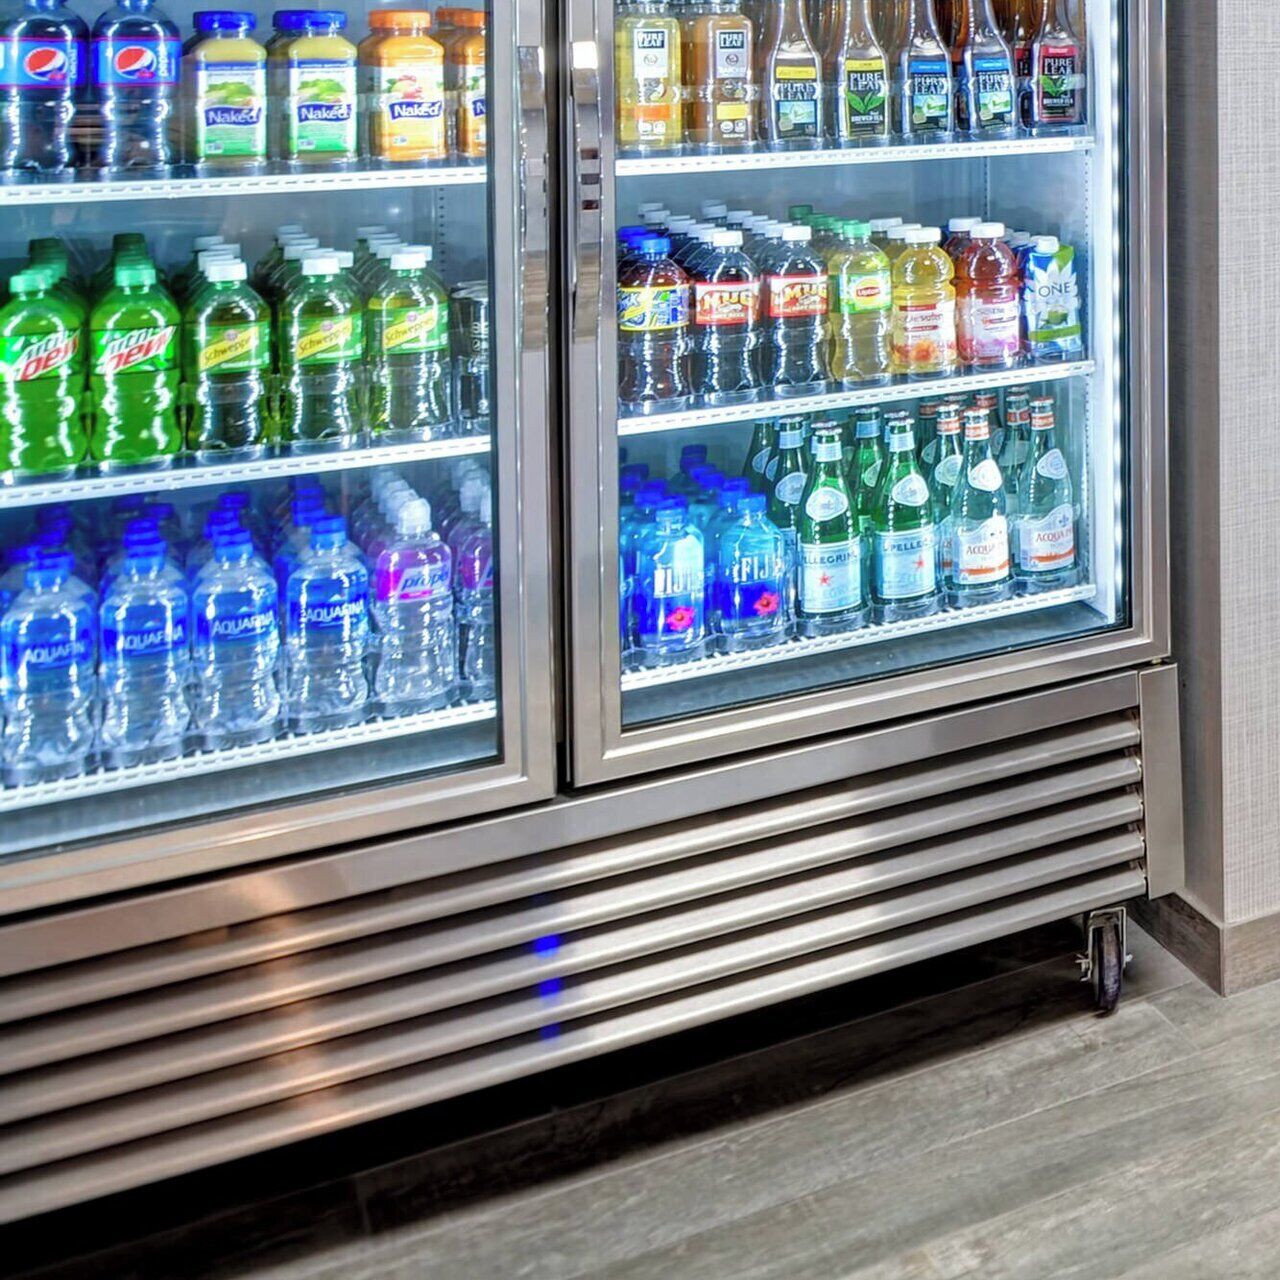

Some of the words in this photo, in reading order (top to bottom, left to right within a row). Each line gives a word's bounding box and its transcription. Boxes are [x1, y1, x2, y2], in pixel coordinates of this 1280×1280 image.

[719, 32, 744, 40] PURE
[719, 39, 744, 48] LEAF
[1044, 57, 1073, 67] PURE
[1044, 65, 1073, 75] LEAF
[850, 72, 882, 81] PURE
[850, 80, 881, 90] LEAF
[209, 101, 257, 124] Naked
[301, 100, 350, 122] Naked
[393, 99, 439, 118] Naked
[783, 283, 828, 301] MUG
[857, 288, 881, 296] Lipton
[703, 288, 752, 309] MUG
[1035, 530, 1065, 543] ACQUA
